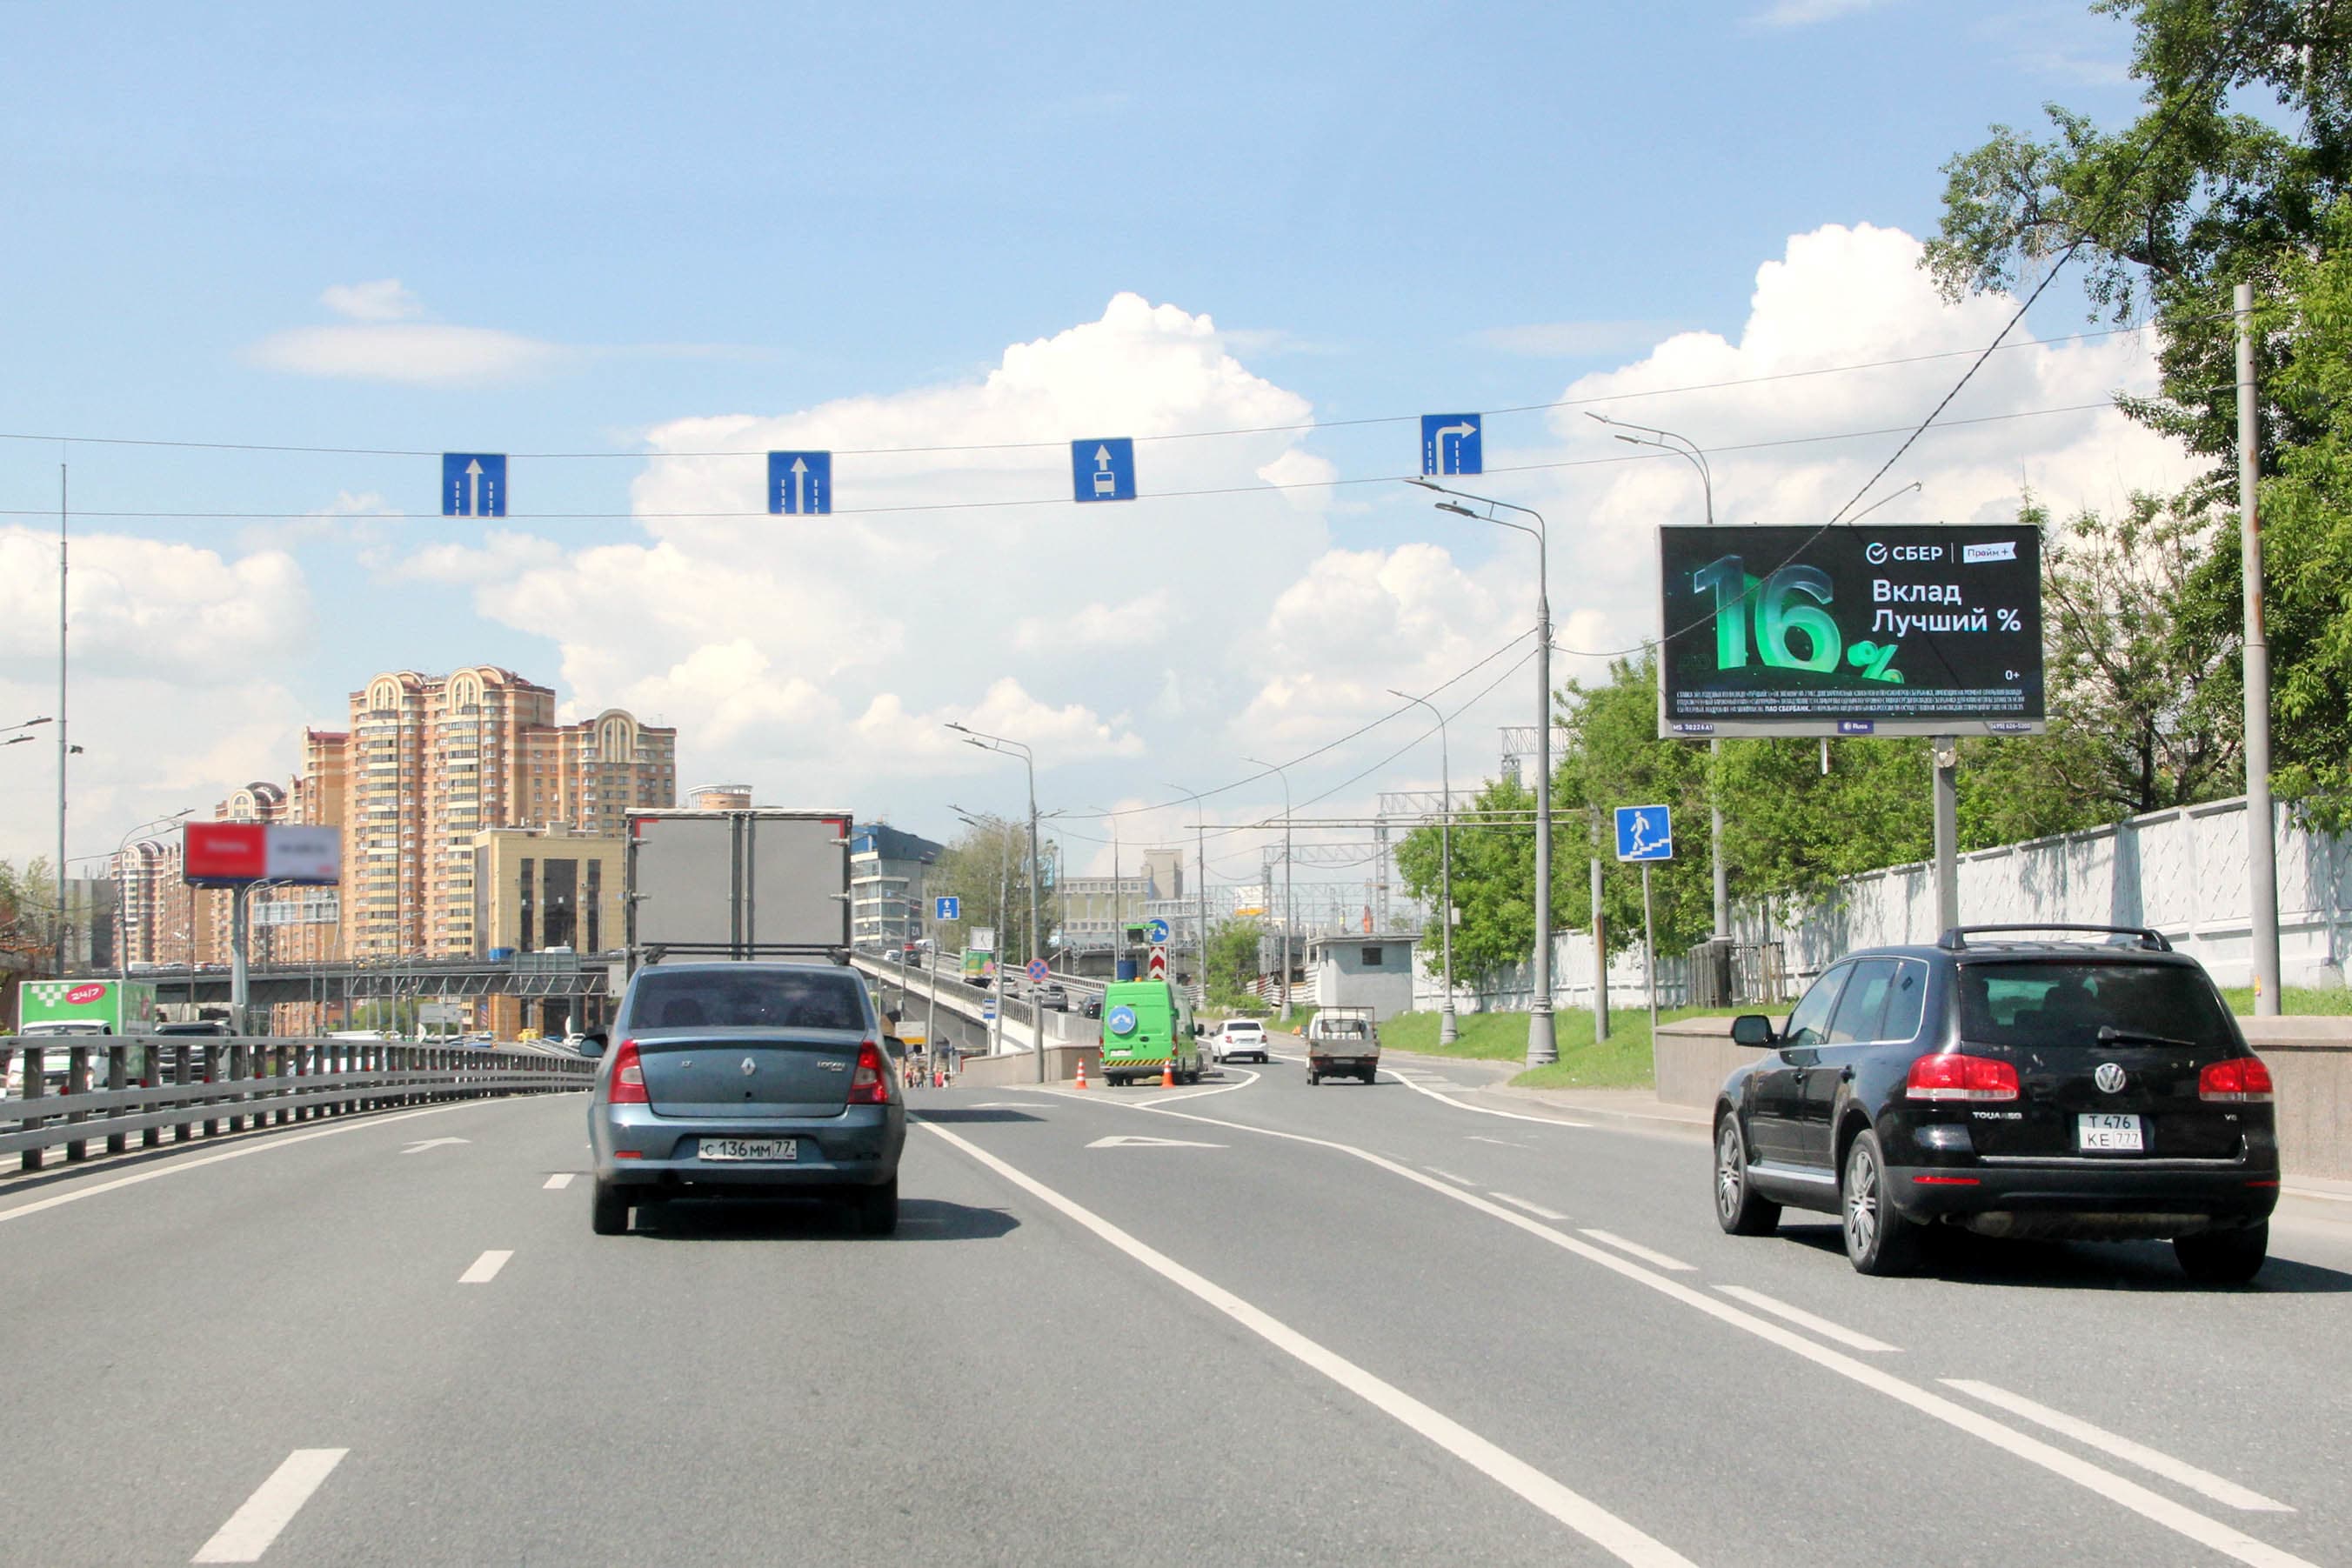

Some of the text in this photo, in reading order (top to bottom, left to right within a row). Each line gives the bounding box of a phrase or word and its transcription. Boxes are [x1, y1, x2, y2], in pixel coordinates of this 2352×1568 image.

[1892, 545, 1943, 561] СБЕР
[1873, 578, 1962, 606] Вклад
[1871, 607, 2022, 638] Лучший %
[2004, 669, 2021, 681] 0+
[2103, 1116, 2131, 1129] 476
[2117, 1132, 2139, 1144] 777
